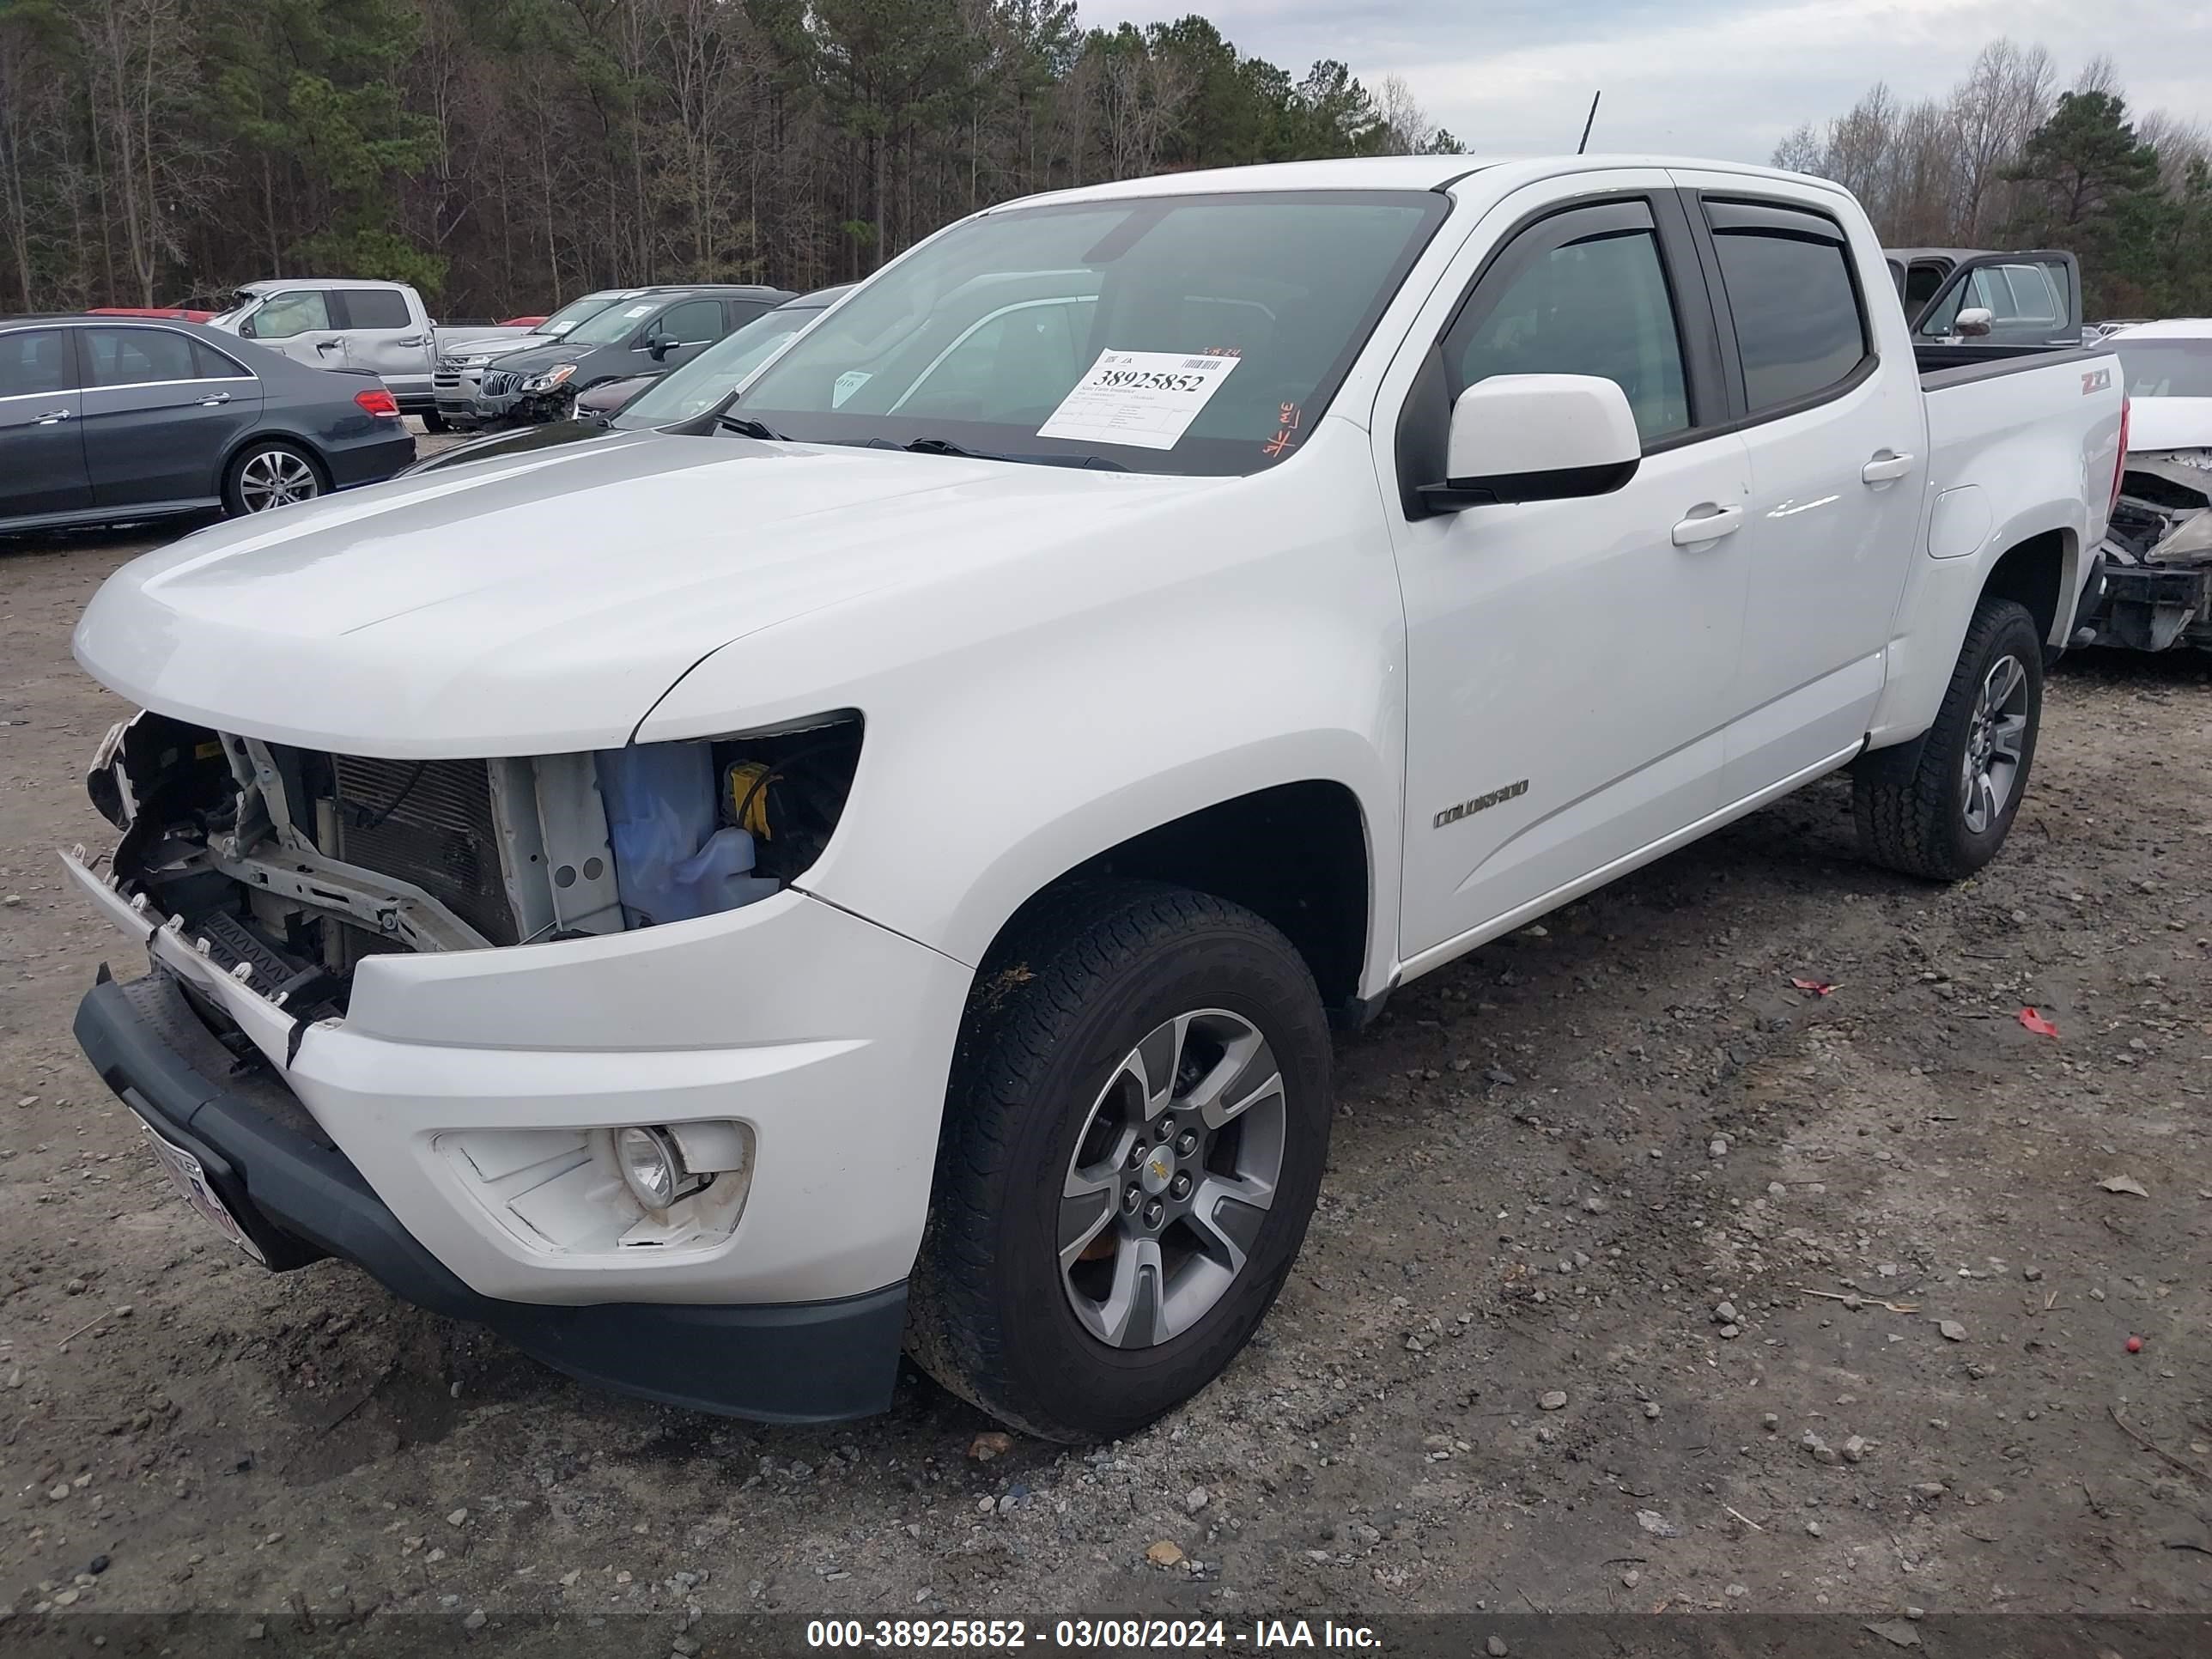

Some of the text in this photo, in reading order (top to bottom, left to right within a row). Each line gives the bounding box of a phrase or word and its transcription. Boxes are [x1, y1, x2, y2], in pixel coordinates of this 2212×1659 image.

[1093, 370, 1205, 392] 38925852
[2081, 368, 2111, 395] Z71
[1433, 779, 1528, 829] COLORADO
